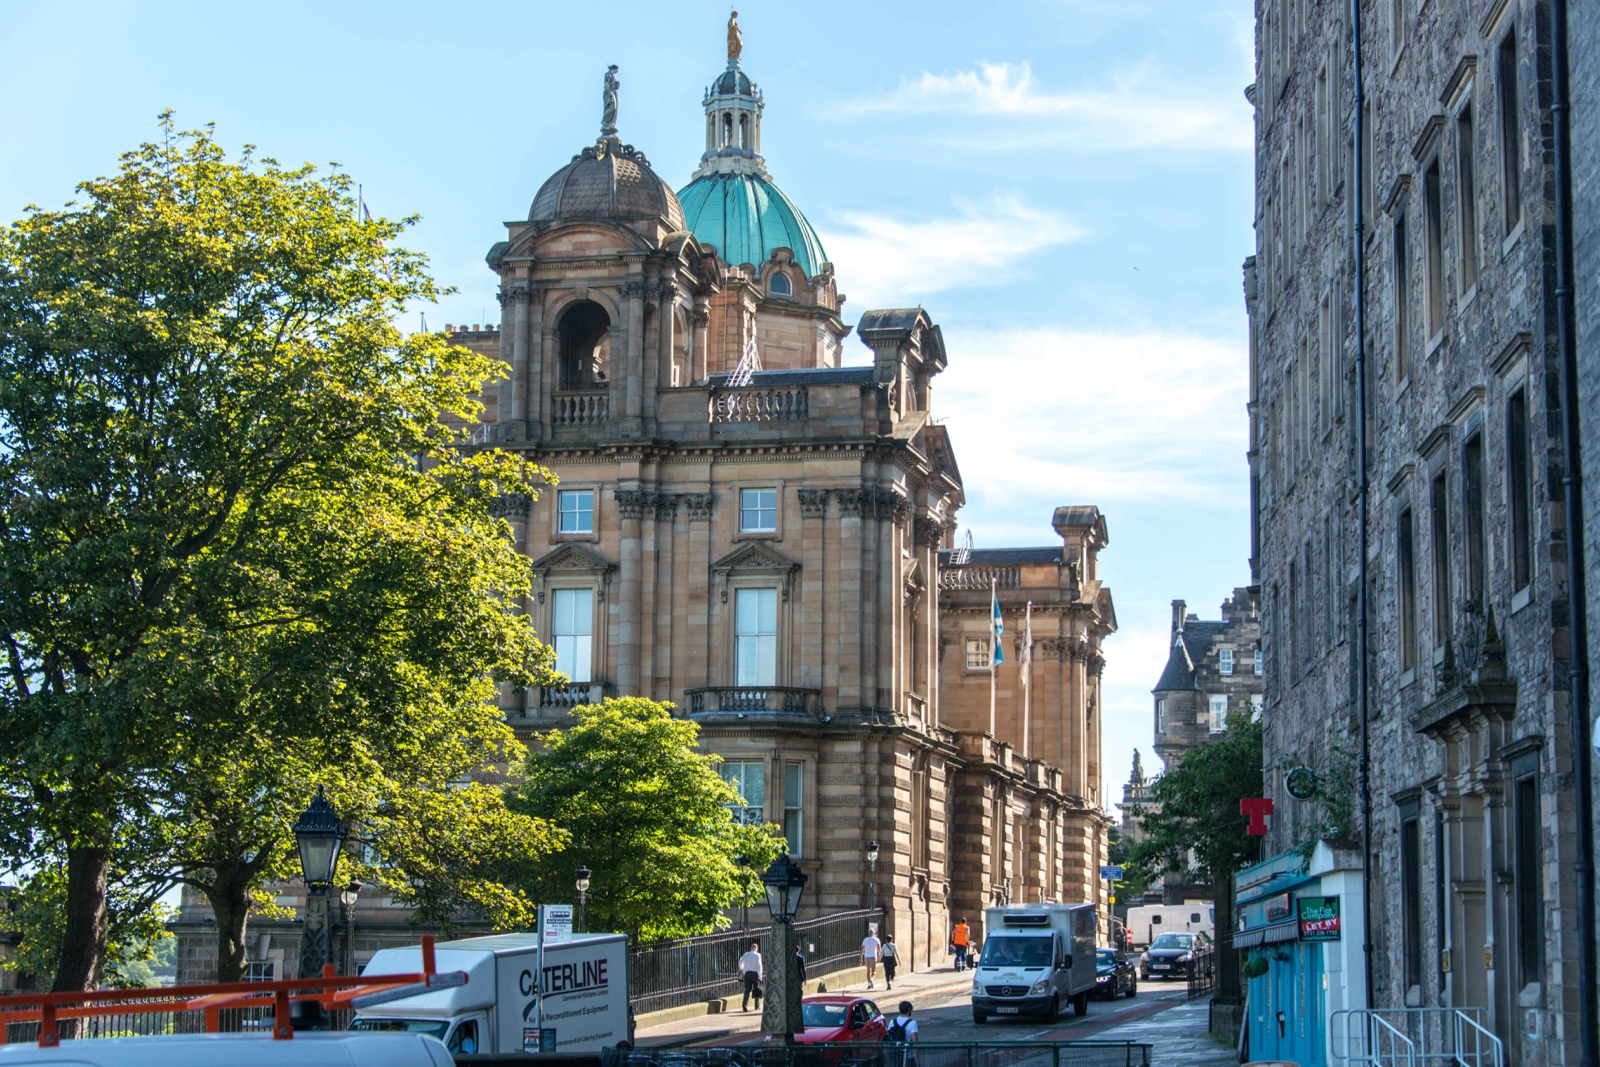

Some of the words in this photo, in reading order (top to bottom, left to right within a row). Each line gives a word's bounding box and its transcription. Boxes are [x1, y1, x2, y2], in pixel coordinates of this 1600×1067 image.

[1301, 911, 1336, 921] Company
[1305, 906, 1318, 915] The
[1319, 906, 1332, 914] Flat
[1305, 921, 1323, 932] LET
[1324, 917, 1338, 927] BY
[562, 993, 583, 1002] Commercial
[582, 991, 597, 999] Kitchens
[596, 989, 609, 997] Limited
[546, 1008, 582, 1021] Reconditioned
[582, 1004, 609, 1016] Equipment
[581, 1034, 596, 1043] Catering
[595, 1030, 613, 1040] Equipment
